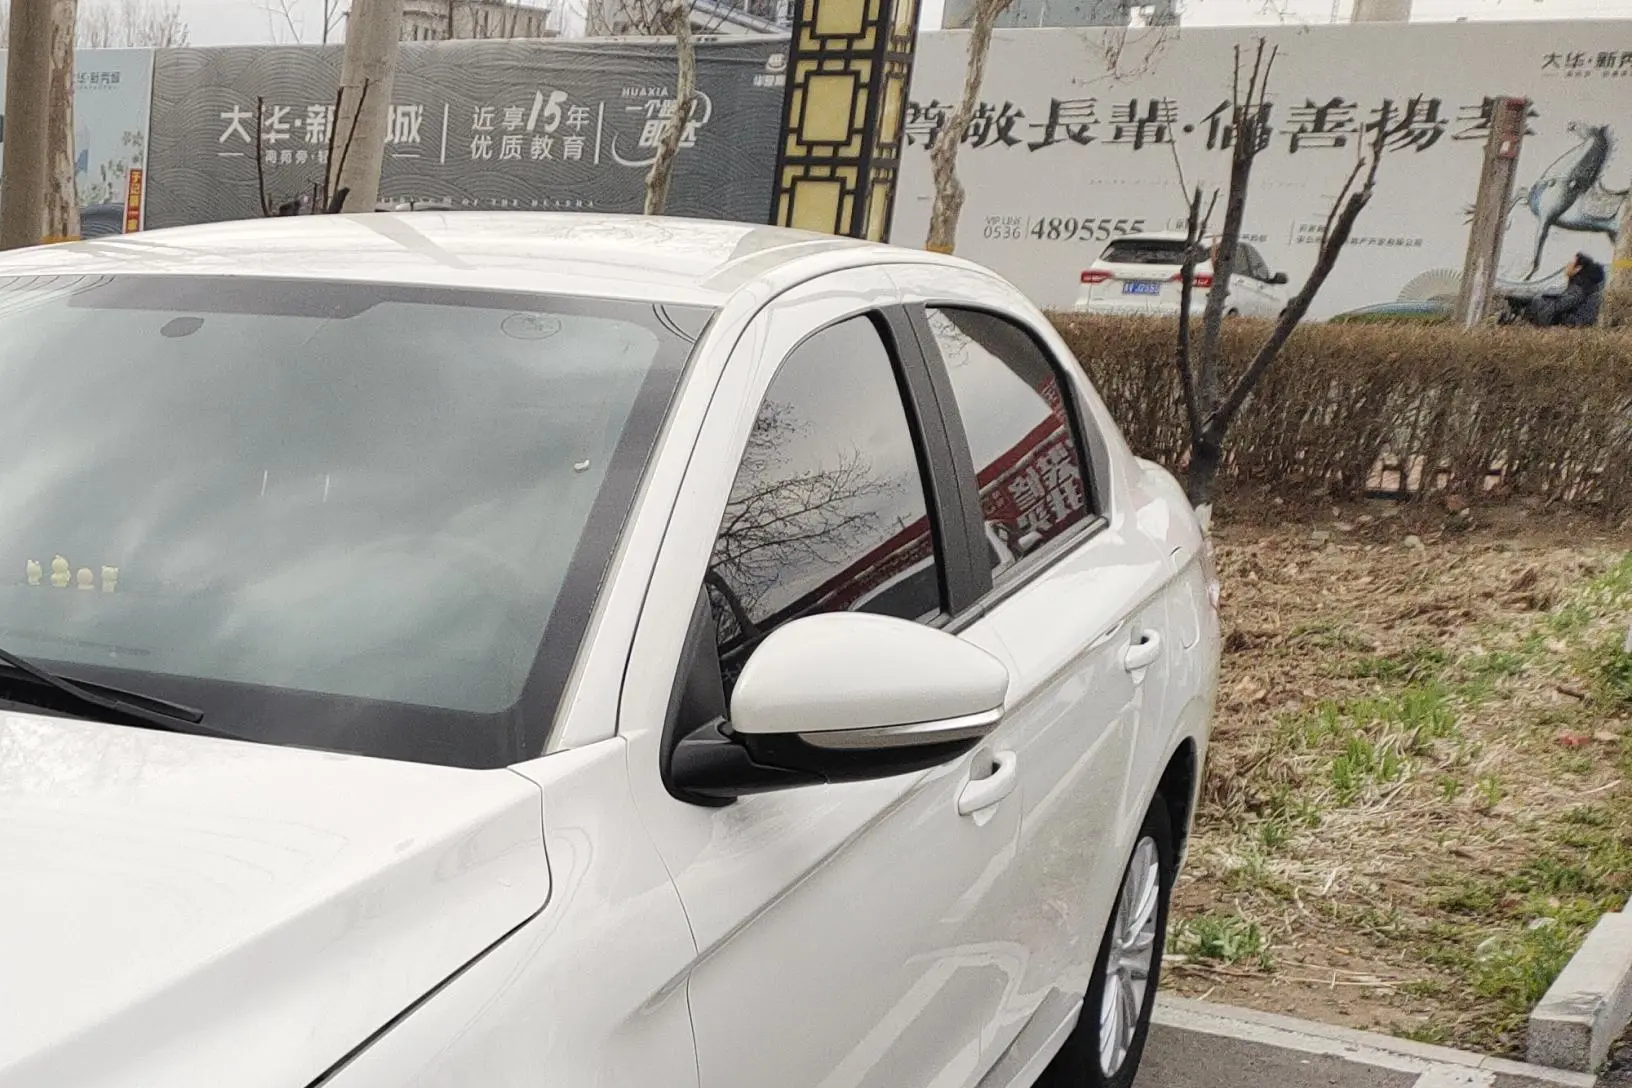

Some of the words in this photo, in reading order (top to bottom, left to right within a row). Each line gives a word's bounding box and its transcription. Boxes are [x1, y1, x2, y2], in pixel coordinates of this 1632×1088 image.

[622, 87, 669, 97] HUAXIA
[219, 104, 424, 143] 大华·新城
[472, 90, 589, 132] 近享15年
[470, 134, 586, 160] 优质教育
[984, 226, 1020, 239] 0536
[1031, 217, 1145, 241] 4895555
